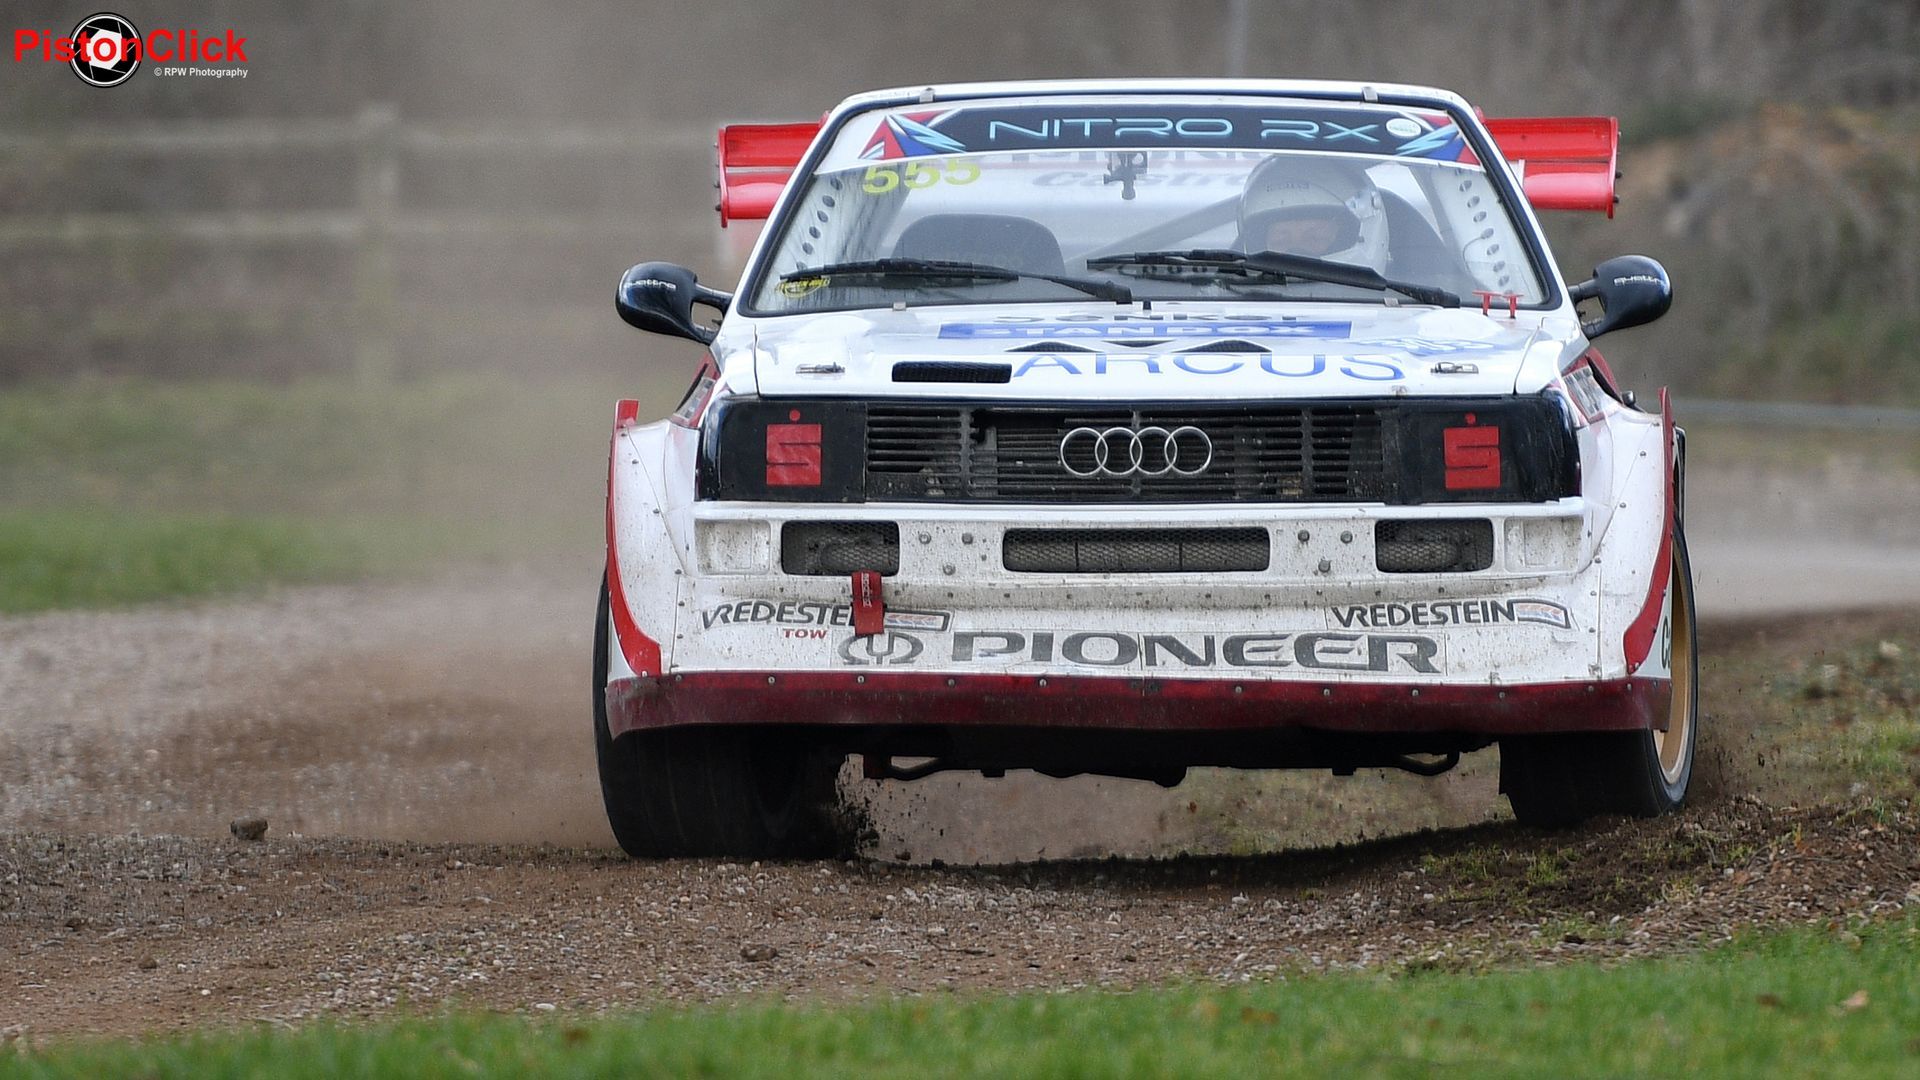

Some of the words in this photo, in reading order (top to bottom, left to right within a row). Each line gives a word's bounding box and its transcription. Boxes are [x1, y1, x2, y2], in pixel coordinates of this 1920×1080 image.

[989, 118, 1233, 140] NITRO
[1261, 119, 1380, 142] RX
[862, 158, 981, 193] 555
[1013, 353, 1406, 380] ARCUS
[702, 600, 856, 629] VREDESTE
[1332, 599, 1515, 628] VREDESTEIN
[783, 628, 828, 639] TOW
[951, 631, 1441, 674] PIONEER
